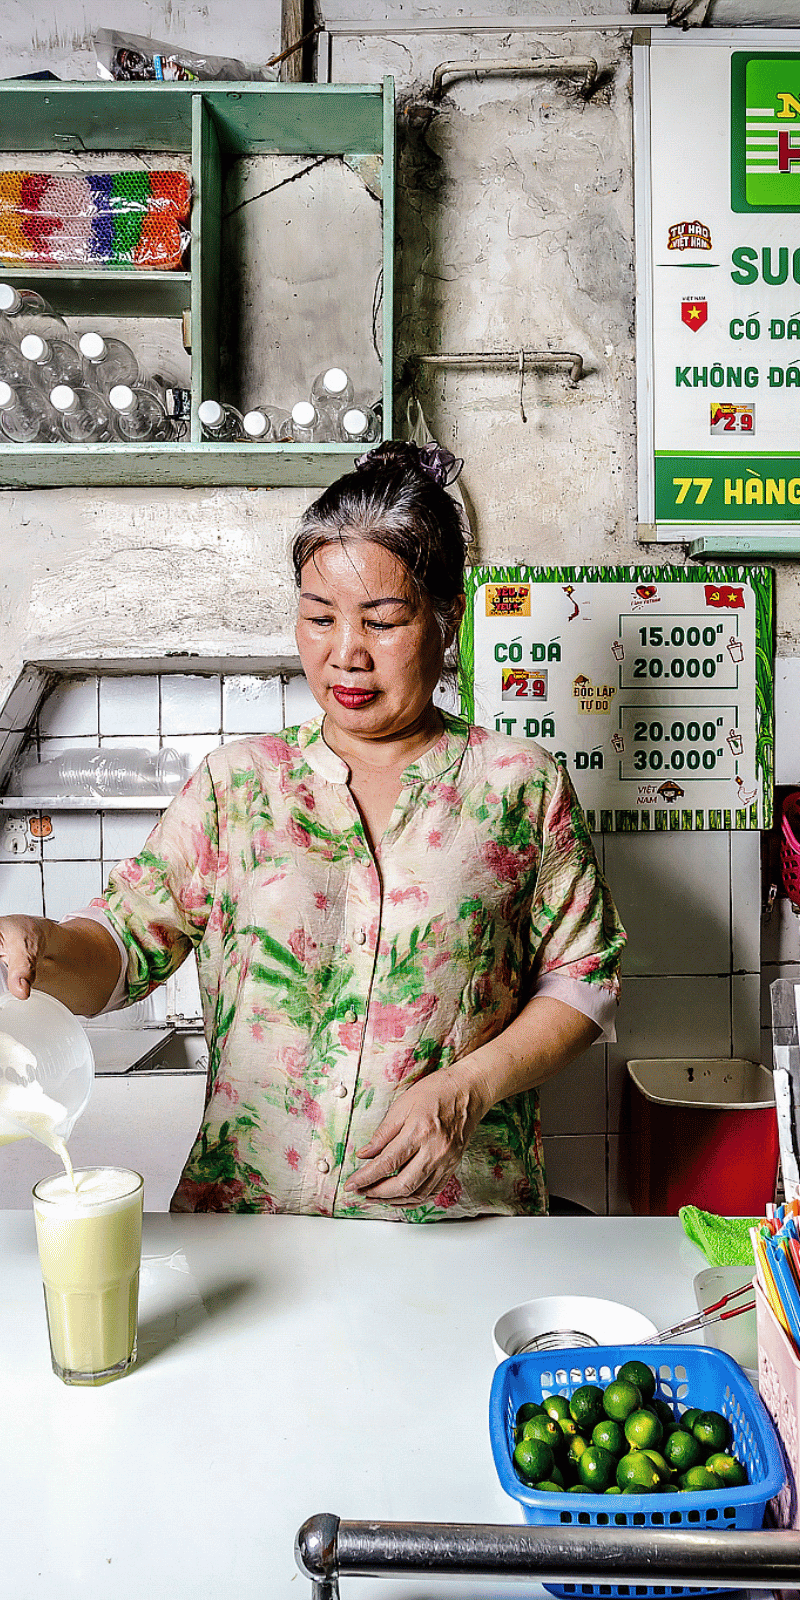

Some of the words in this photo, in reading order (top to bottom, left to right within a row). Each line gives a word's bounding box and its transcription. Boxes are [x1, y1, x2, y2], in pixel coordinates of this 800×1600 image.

[731, 246, 800, 285] SU
[730, 311, 760, 340] CÓ
[768, 311, 800, 340] ĐÁ
[675, 363, 759, 388] KHÔNG
[767, 359, 800, 387] ĐÁ
[673, 478, 713, 504] 77
[724, 468, 800, 505] HÀNG
[494, 636, 522, 662] CÓ
[530, 636, 561, 662] ĐÁ
[494, 712, 517, 735] ÍT
[523, 712, 555, 737] ĐÁ
[574, 746, 603, 769] ĐÁ
